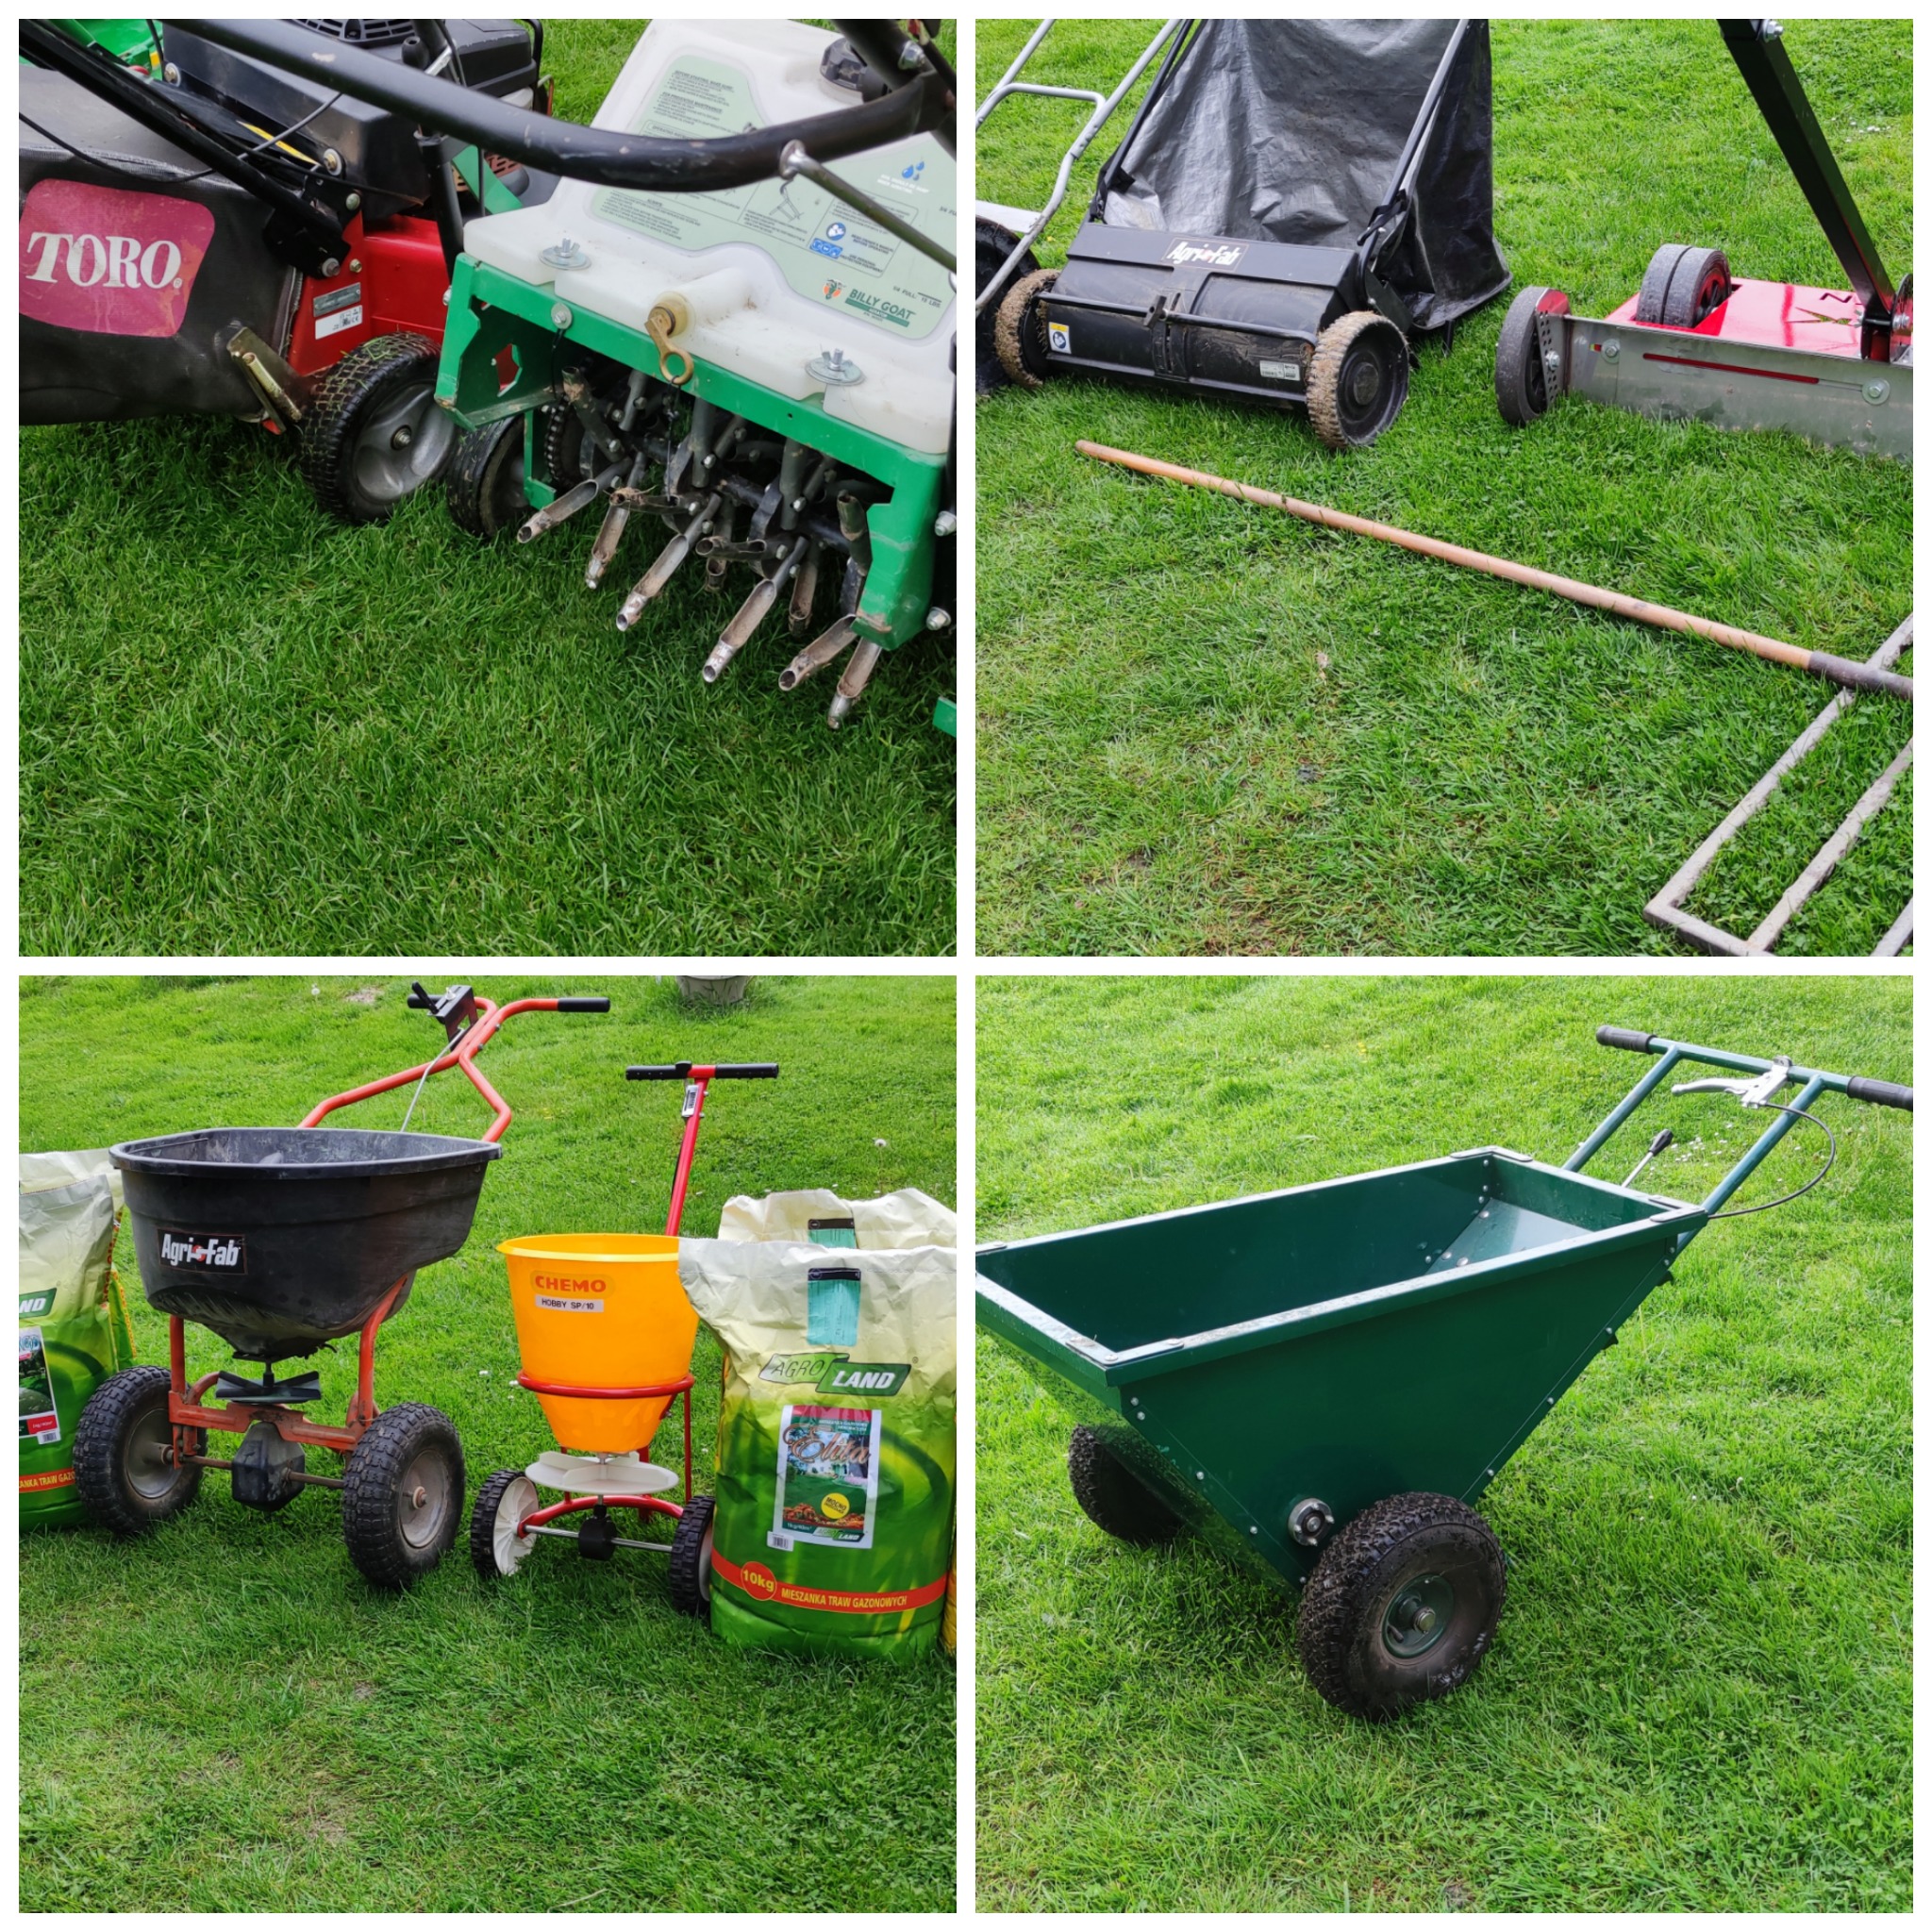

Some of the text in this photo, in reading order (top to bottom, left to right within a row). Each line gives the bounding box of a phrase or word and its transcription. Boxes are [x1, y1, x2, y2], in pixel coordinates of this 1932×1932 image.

[25, 232, 182, 289] TORO
[849, 289, 880, 307] BILLY
[880, 301, 914, 320] GOAT
[535, 1275, 607, 1293] CHEMO
[541, 1297, 594, 1310] HOBBY SP/10
[771, 1359, 895, 1389] AGRO LAND
[39, 1474, 57, 1486] TRAW
[742, 1569, 774, 1592] 10kg
[781, 1587, 908, 1608] MIESZANKA TRAW GAZONOWYCH
